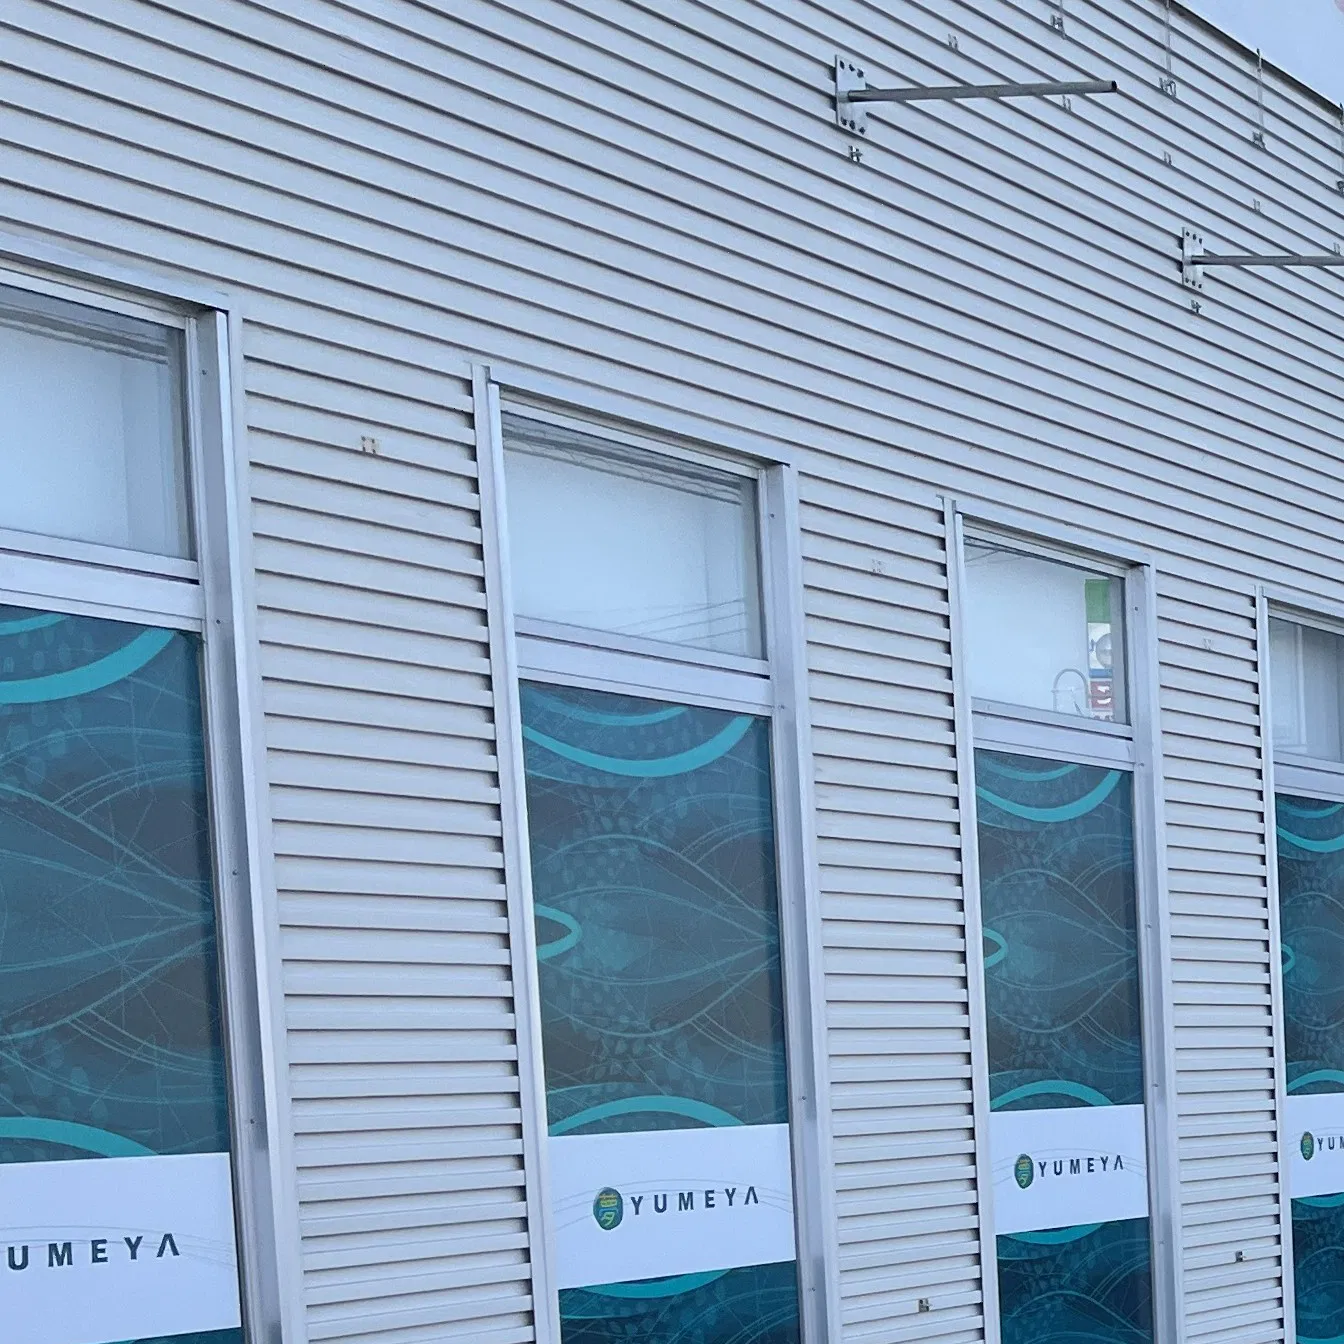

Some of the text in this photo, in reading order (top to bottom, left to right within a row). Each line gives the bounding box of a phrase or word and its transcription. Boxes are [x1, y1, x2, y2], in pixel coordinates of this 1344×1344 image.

[1037, 1154, 1124, 1178] YUMEYA
[630, 1185, 759, 1216] YUMEYA
[7, 1233, 181, 1271] UMEYA
